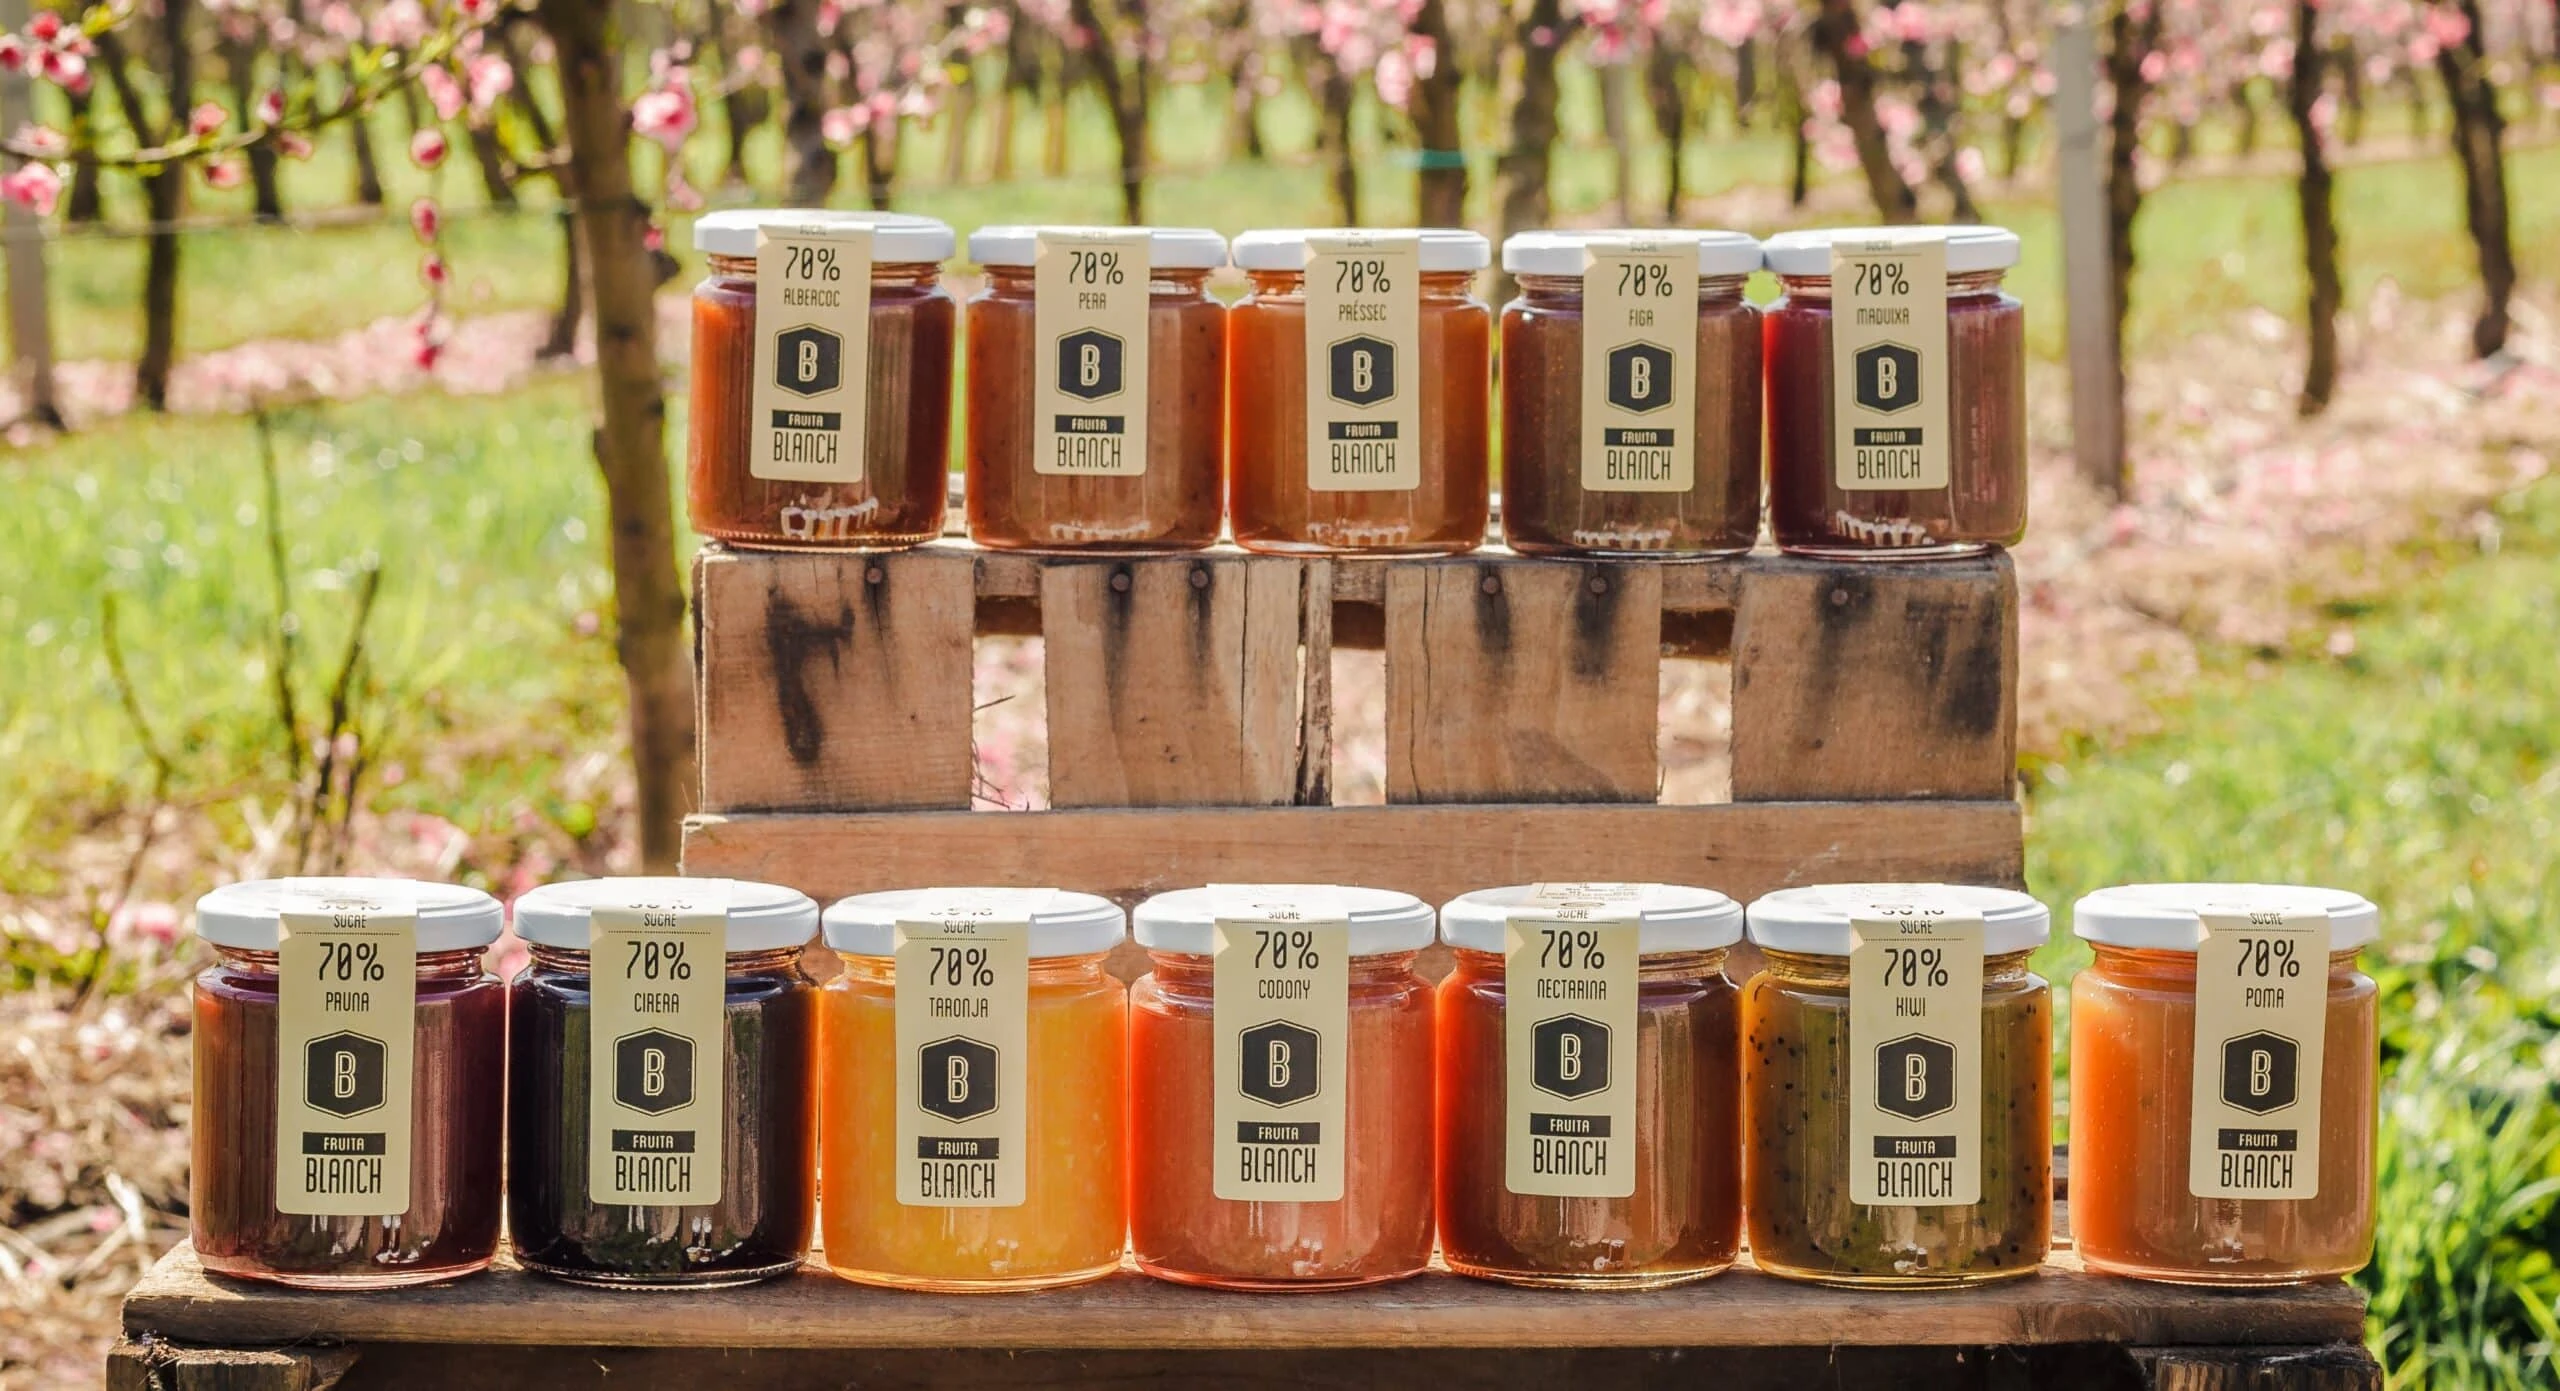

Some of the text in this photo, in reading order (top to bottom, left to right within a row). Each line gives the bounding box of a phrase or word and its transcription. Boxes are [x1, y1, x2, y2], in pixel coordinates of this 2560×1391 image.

[785, 245, 841, 282] 70%
[1069, 251, 1124, 285] 70%
[1335, 260, 1391, 294] 70%
[1618, 263, 1673, 297] 70%
[1854, 263, 1910, 296] 70%
[783, 287, 841, 308] ALBERCOC
[1078, 291, 1107, 310] PERA
[1338, 299, 1387, 322] PRÉSSEC
[1628, 308, 1654, 327] FIGA
[1856, 307, 1910, 326] MADUIXA
[798, 340, 818, 382] B
[1080, 343, 1101, 387] B
[1352, 350, 1373, 393] B
[1630, 356, 1651, 399] B
[1877, 356, 1897, 400] B
[787, 413, 824, 428] FRUITA
[1070, 418, 1107, 432] FRUITA
[1345, 424, 1381, 438] FRUITA
[1870, 430, 1907, 444] FRUITA
[773, 431, 838, 466] BLANCH
[1056, 434, 1122, 469] BLANCH
[1621, 431, 1657, 445] FRUITA
[1331, 442, 1396, 474] BLANCH
[1605, 448, 1672, 482] BLANCH
[1855, 447, 1922, 481] BLANCH
[333, 914, 368, 929] SUCRE
[643, 913, 677, 928] SUCRE
[943, 919, 977, 935] SUCRE
[1899, 919, 1933, 935] SUCRE
[2249, 912, 2284, 926] SUCRE
[318, 942, 385, 982] 70%
[626, 940, 691, 981] 70%
[1255, 930, 1319, 970] 70%
[1541, 929, 1605, 970] 70%
[2237, 938, 2300, 978] 70%
[930, 947, 994, 987] 70%
[1884, 948, 1949, 987] 70%
[325, 991, 370, 1013] PRUNA
[634, 992, 680, 1014] CIRERA
[1258, 979, 1311, 1000] CODONY
[1537, 978, 1607, 1001] NECTARINA
[1896, 996, 1926, 1017] KIWI
[2245, 987, 2285, 1009] POMA
[928, 996, 989, 1018] TARONJA
[334, 1050, 357, 1098] B
[643, 1048, 666, 1097] B
[1269, 1040, 1291, 1088] B
[1560, 1033, 1581, 1081] B
[2250, 1049, 2272, 1096] B
[947, 1055, 969, 1103] B
[1905, 1053, 1927, 1102] B
[632, 1134, 674, 1149] FRUITA
[1258, 1126, 1299, 1141] FRUITA
[1550, 1118, 1590, 1133] FRUITA
[2239, 1133, 2278, 1147] FRUITA
[323, 1136, 365, 1152] FRUITA
[937, 1141, 978, 1156] FRUITA
[1533, 1137, 1608, 1177] BLANCH
[1895, 1140, 1936, 1155] FRUITA
[304, 1155, 383, 1195] BLANCH
[615, 1154, 691, 1193] BLANCH
[921, 1161, 995, 1199] BLANCH
[1240, 1146, 1316, 1184] BLANCH
[1877, 1160, 1953, 1198] BLANCH
[2220, 1152, 2293, 1189] BLANCH
